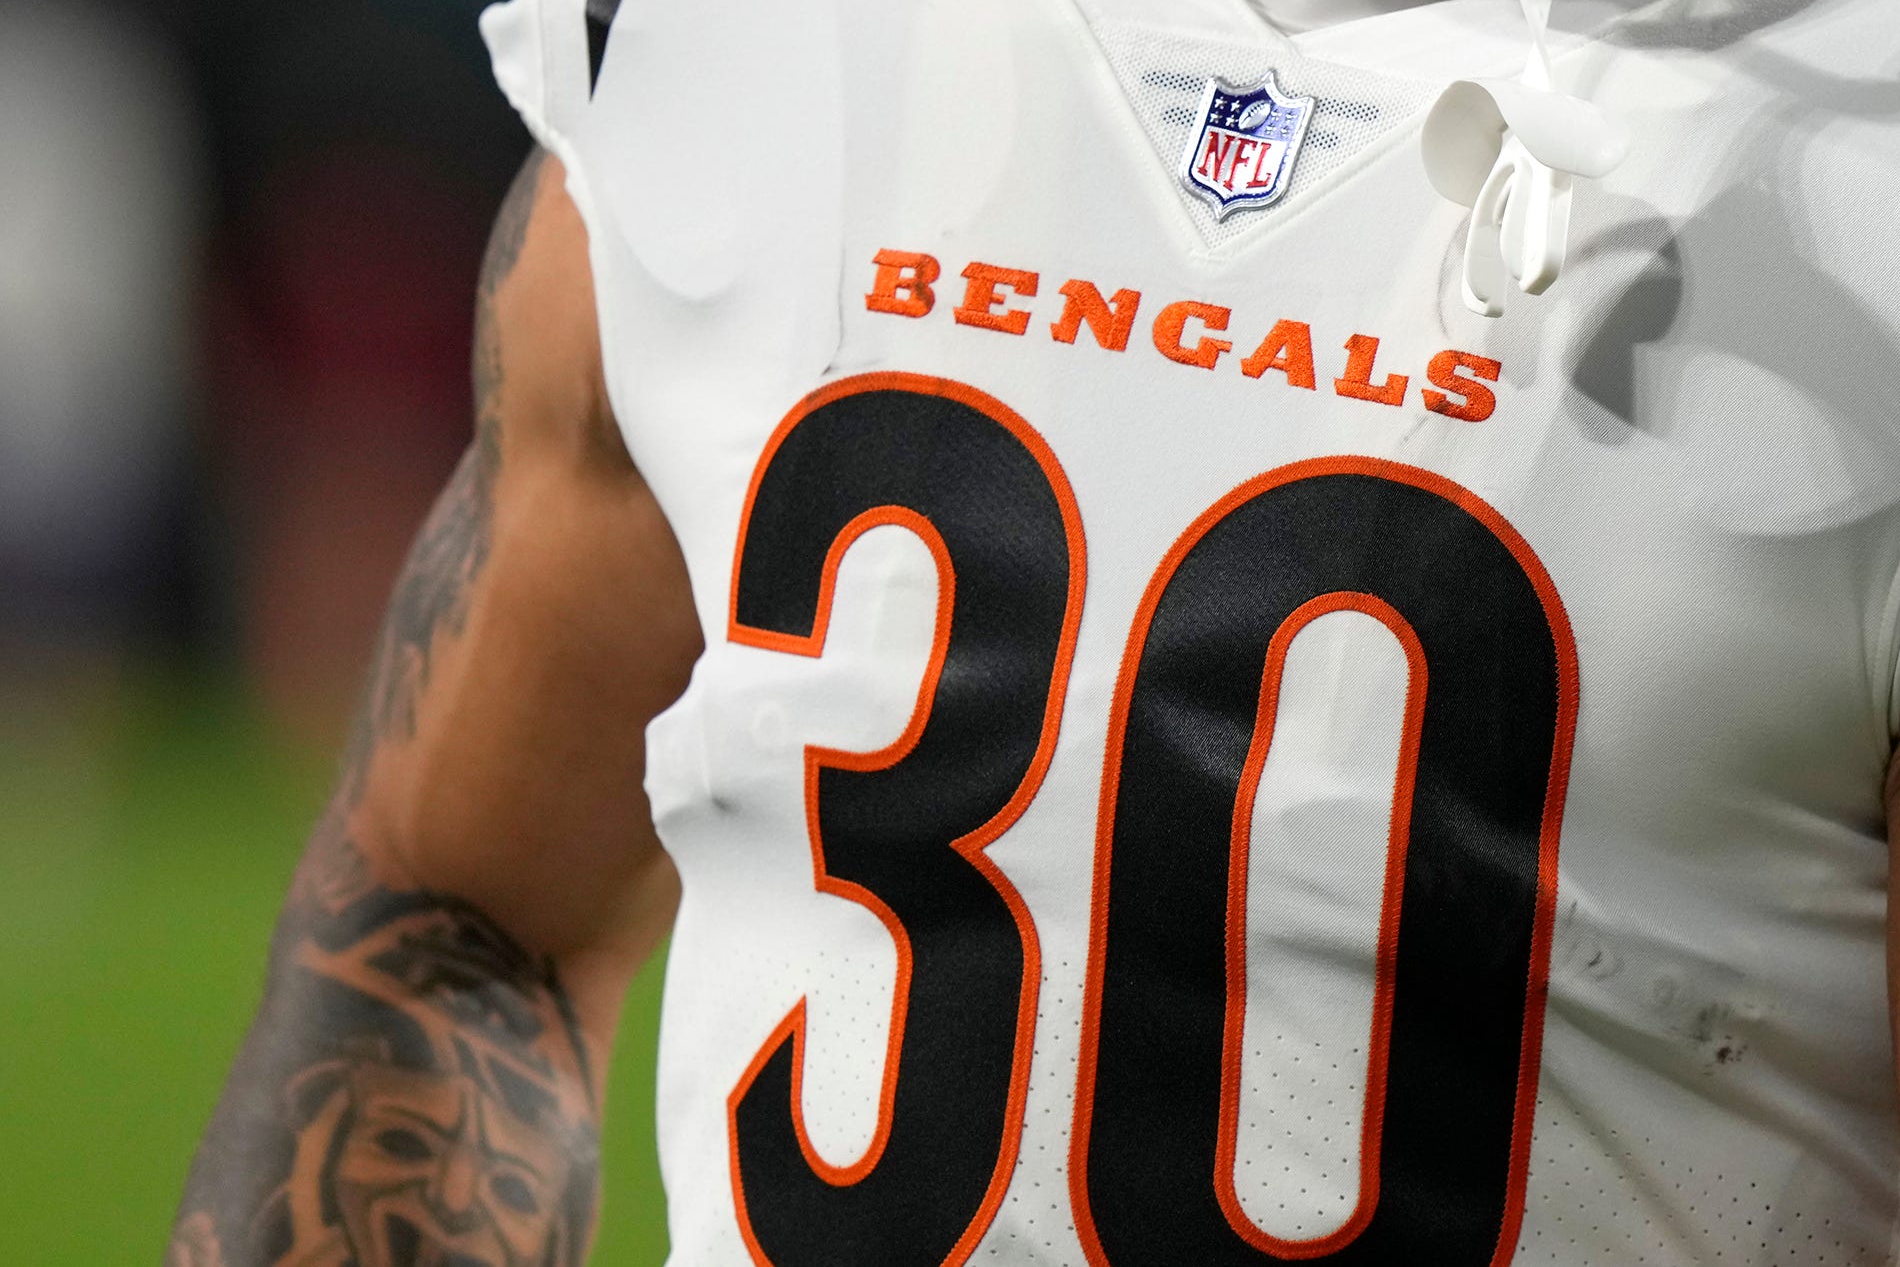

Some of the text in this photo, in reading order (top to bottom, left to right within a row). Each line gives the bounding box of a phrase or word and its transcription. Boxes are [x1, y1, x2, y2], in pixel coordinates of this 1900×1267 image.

[1197, 131, 1272, 192] NFL
[865, 248, 1502, 423] BENGALS
[727, 370, 1581, 1267] 30
